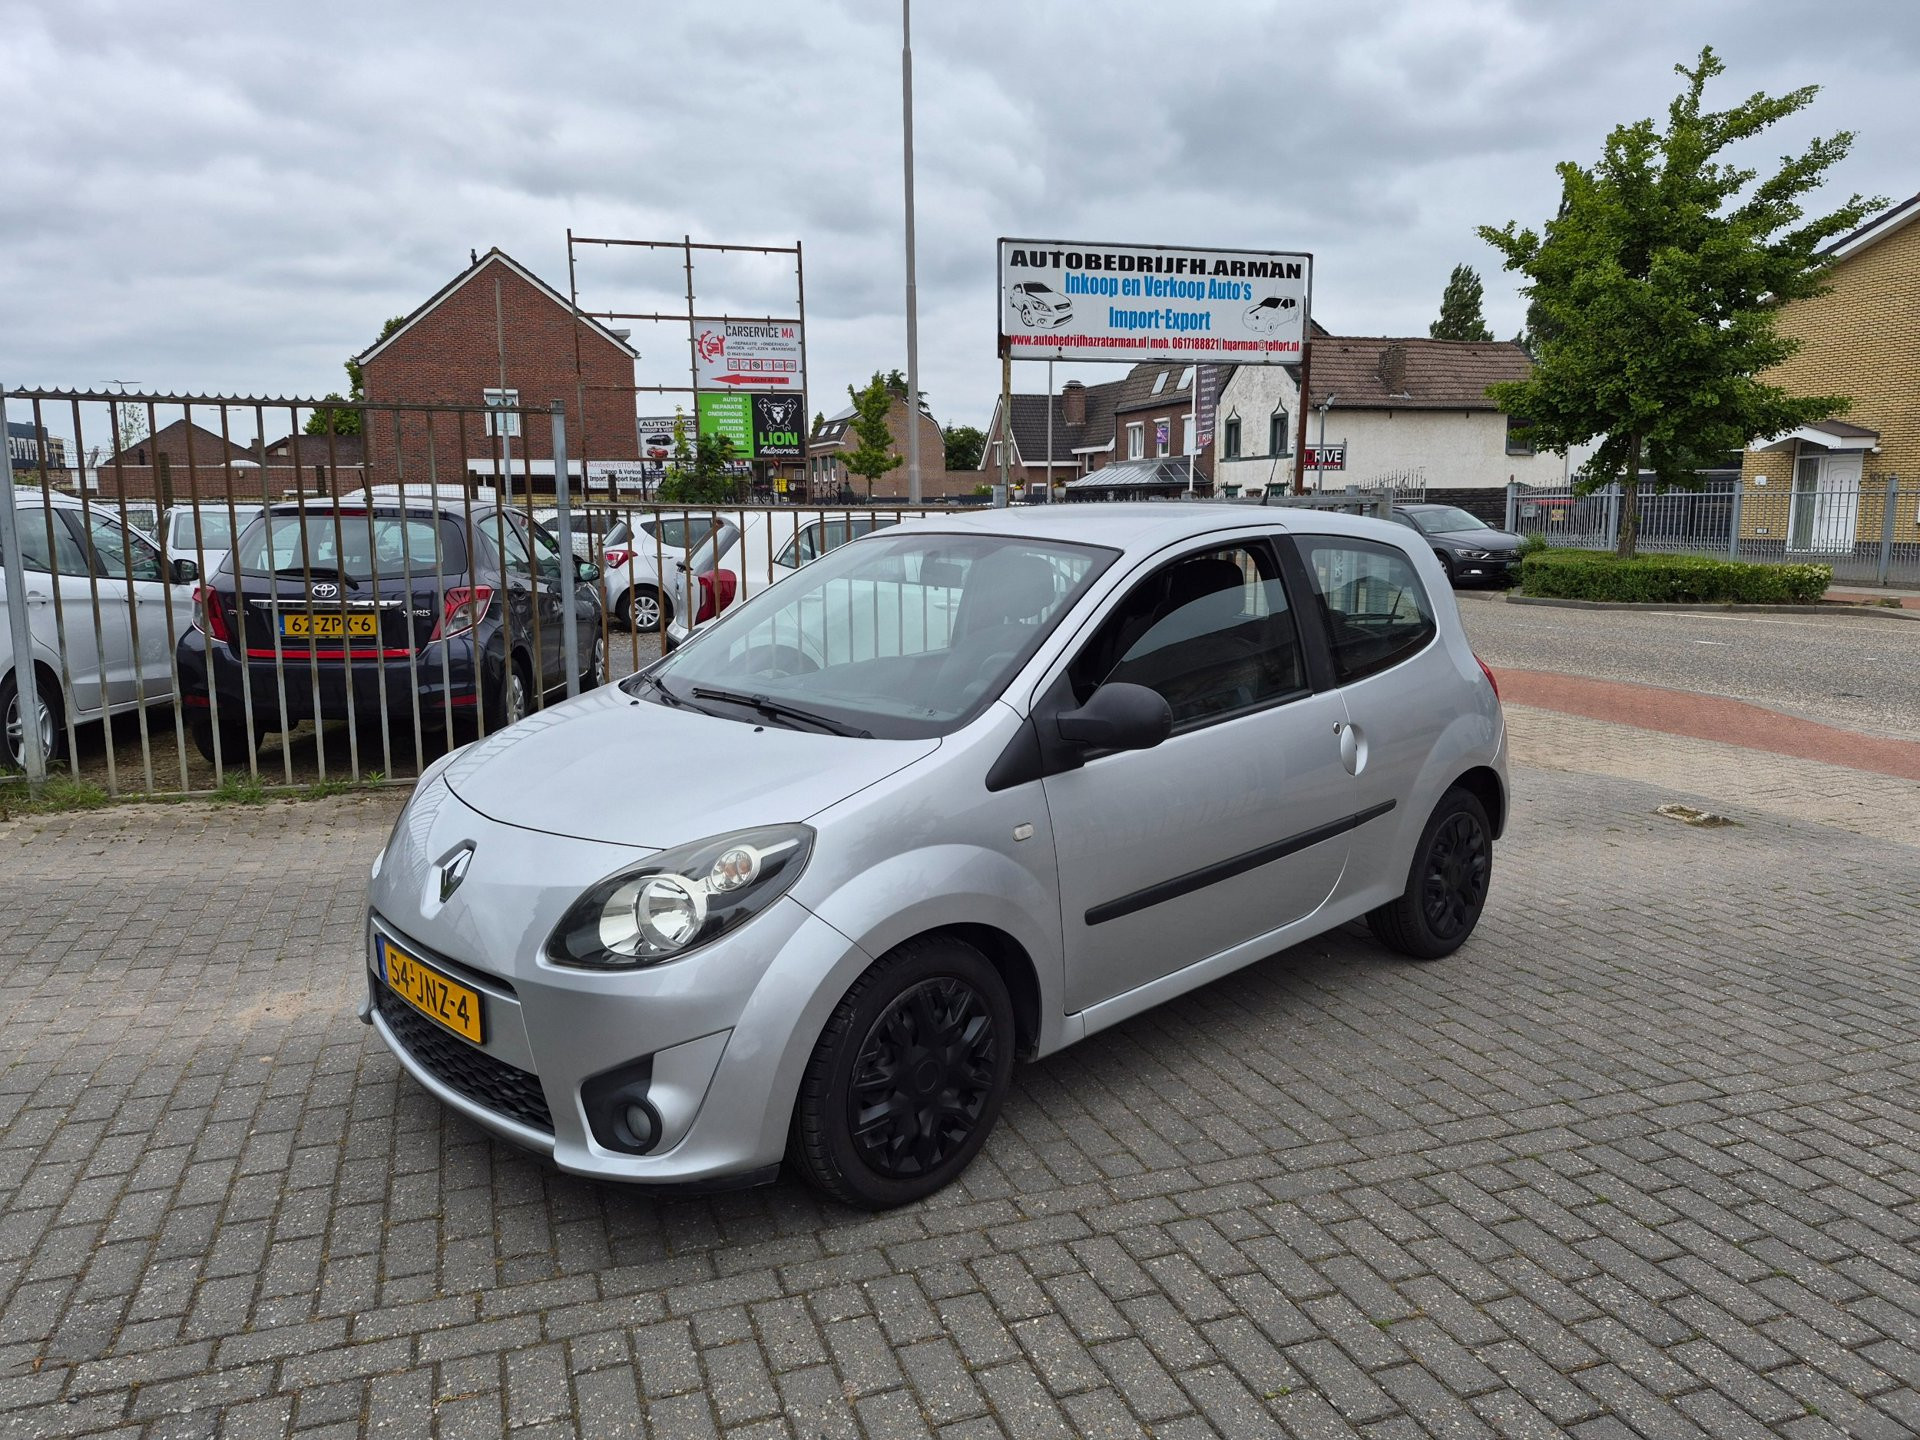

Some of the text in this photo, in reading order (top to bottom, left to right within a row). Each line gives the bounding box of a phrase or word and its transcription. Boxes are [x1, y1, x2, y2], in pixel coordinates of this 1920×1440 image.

[1010, 249, 1301, 279] AUTOBEDRIJFH.ARMAN
[1065, 272, 1252, 300] Inkoop en Verkoop Auto's
[1109, 306, 1211, 332] Import-Export
[725, 325, 794, 338] CARSERVICE MA
[1150, 337, 1170, 349] mob.
[759, 431, 798, 445] LION
[760, 446, 800, 455] Autoservice
[390, 952, 470, 1030] 54-JNZ-4
